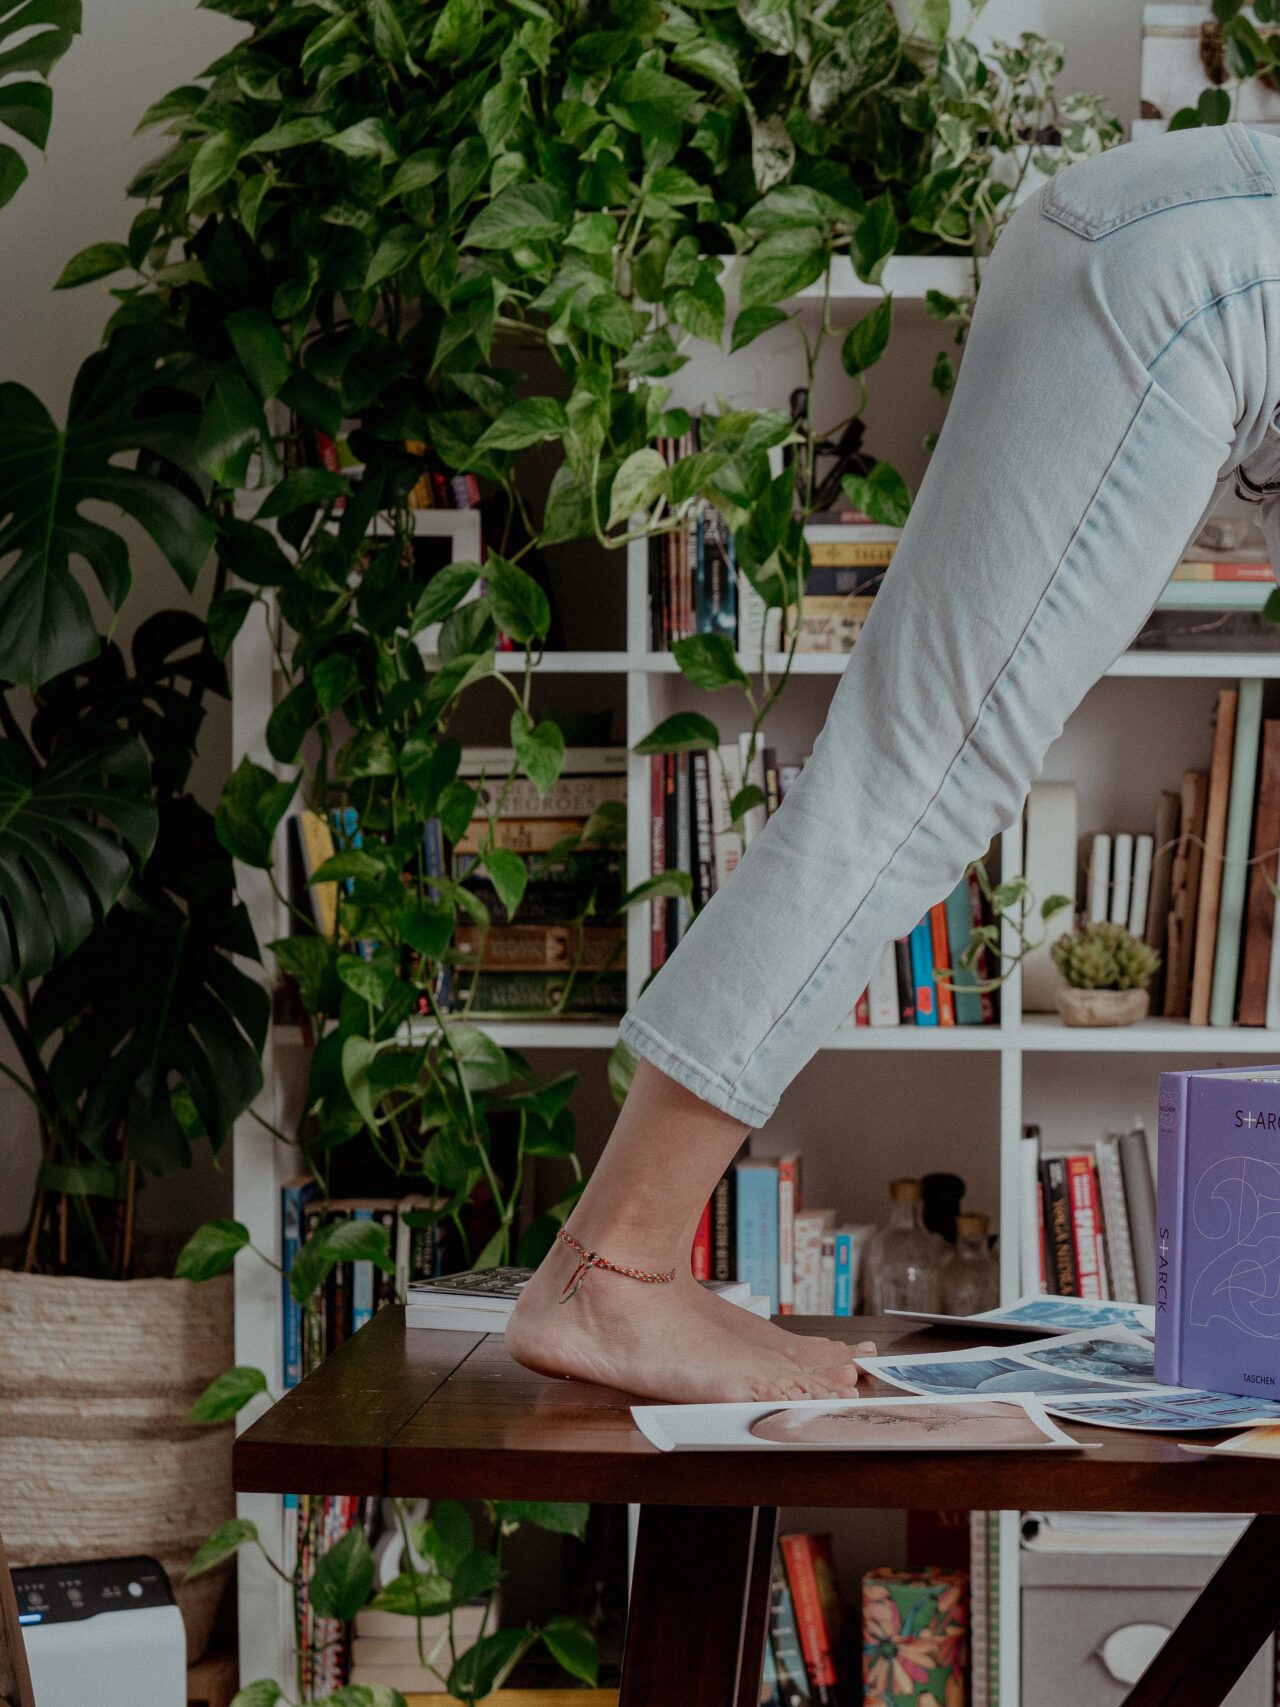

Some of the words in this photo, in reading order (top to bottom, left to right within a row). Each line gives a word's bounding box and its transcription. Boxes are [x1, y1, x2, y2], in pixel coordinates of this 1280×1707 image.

[1052, 1198, 1069, 1243] YOGA
[1074, 1208, 1097, 1274] SPANISH
[1056, 1243, 1074, 1296] NIDRA
[1243, 1373, 1276, 1386] TASCHEN
